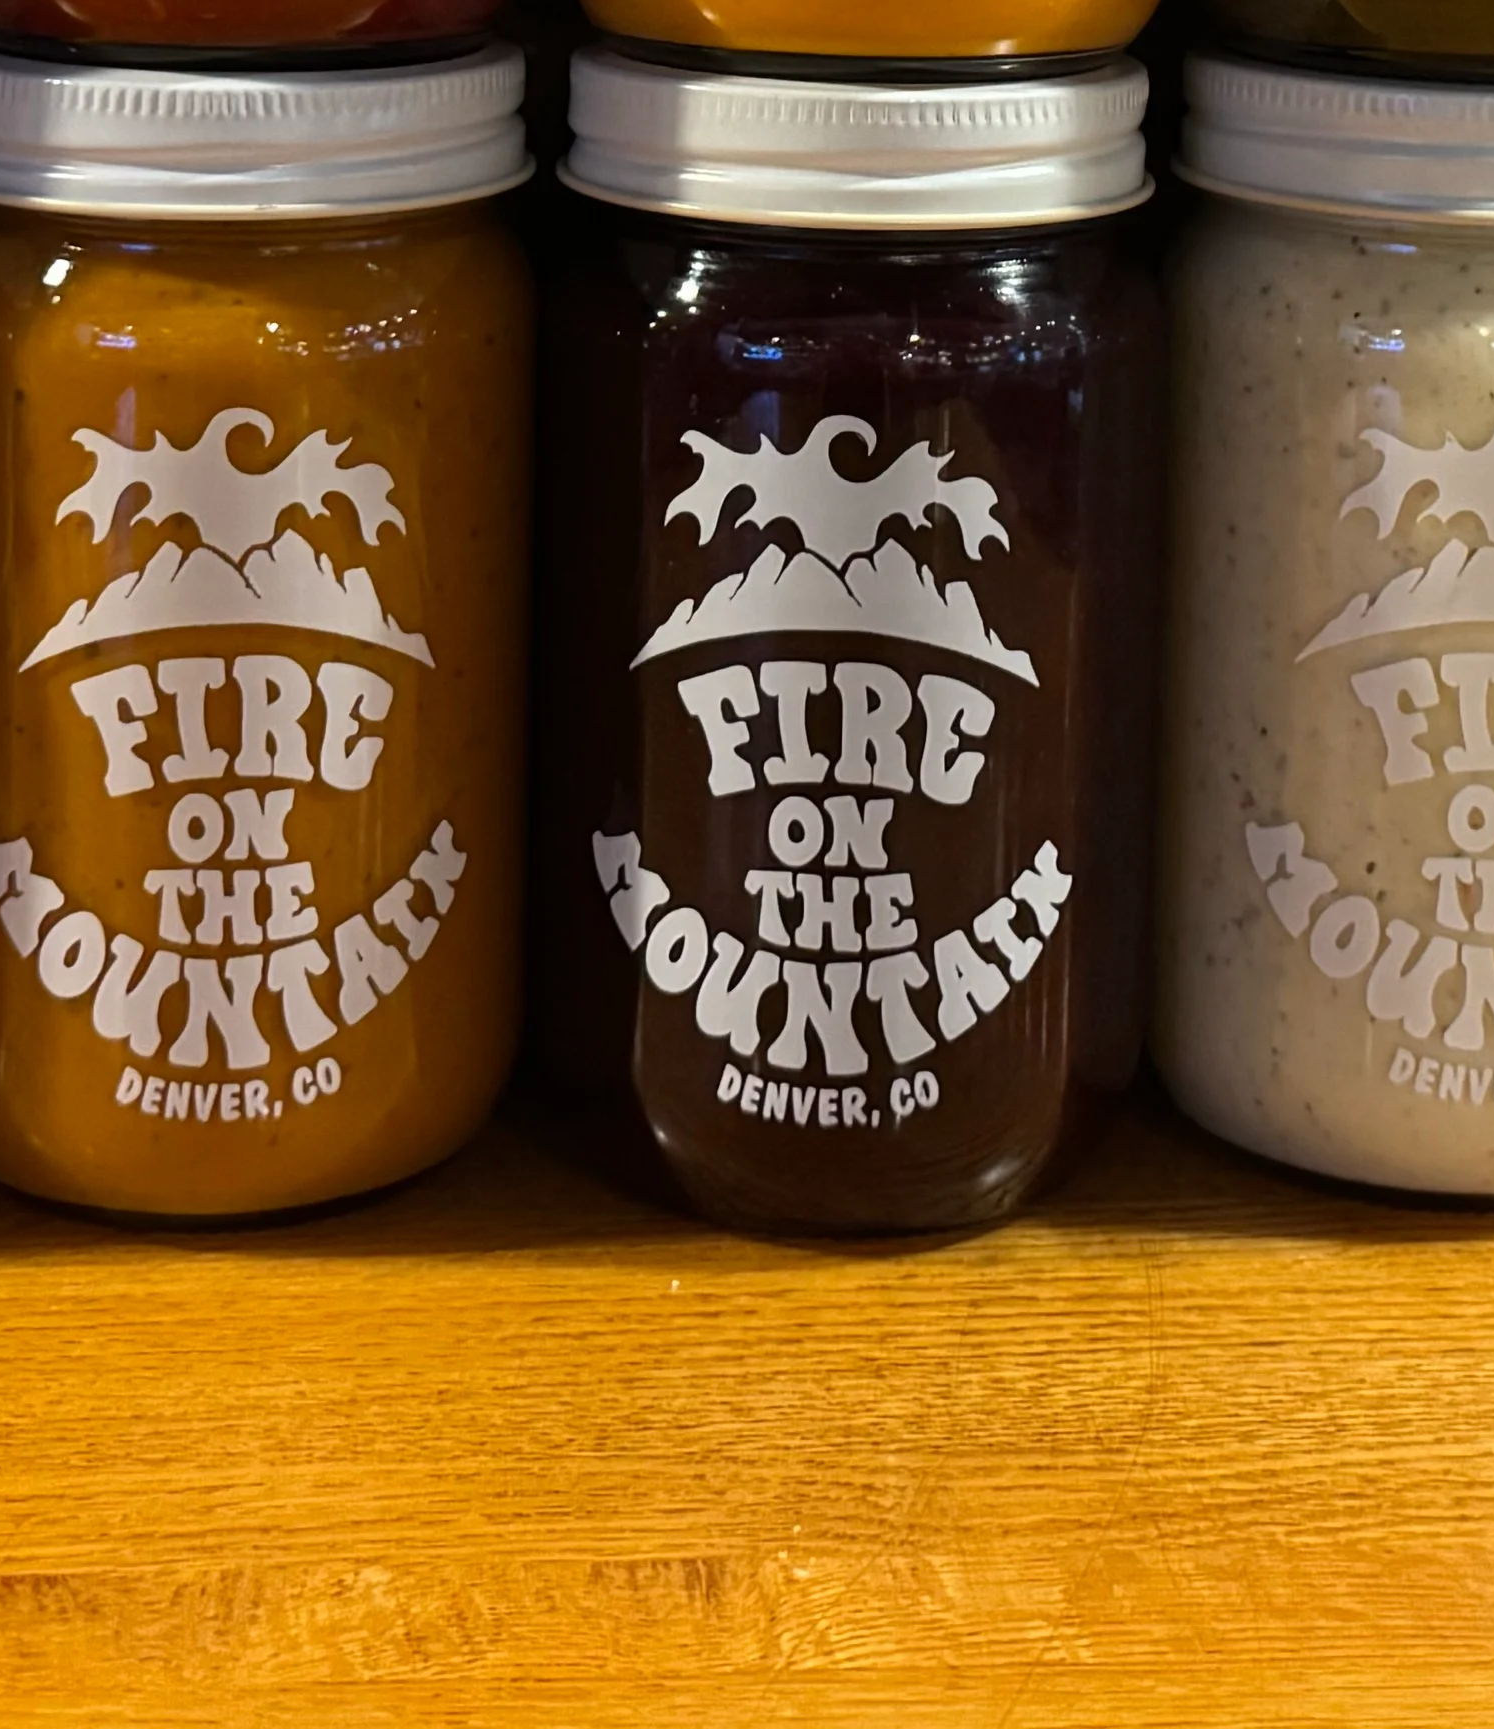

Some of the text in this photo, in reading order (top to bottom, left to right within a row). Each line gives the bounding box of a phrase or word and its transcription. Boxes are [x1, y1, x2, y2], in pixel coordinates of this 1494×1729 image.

[70, 657, 393, 796] FIRE
[677, 661, 994, 805] FIRE
[168, 788, 296, 863] ON
[768, 796, 894, 869] ON
[144, 861, 319, 947] THE
[745, 871, 917, 953] THE
[593, 828, 1071, 1077] MOUNTAIN
[115, 1058, 341, 1125] DENVER, CO
[718, 1064, 939, 1129] DENVER, CO
